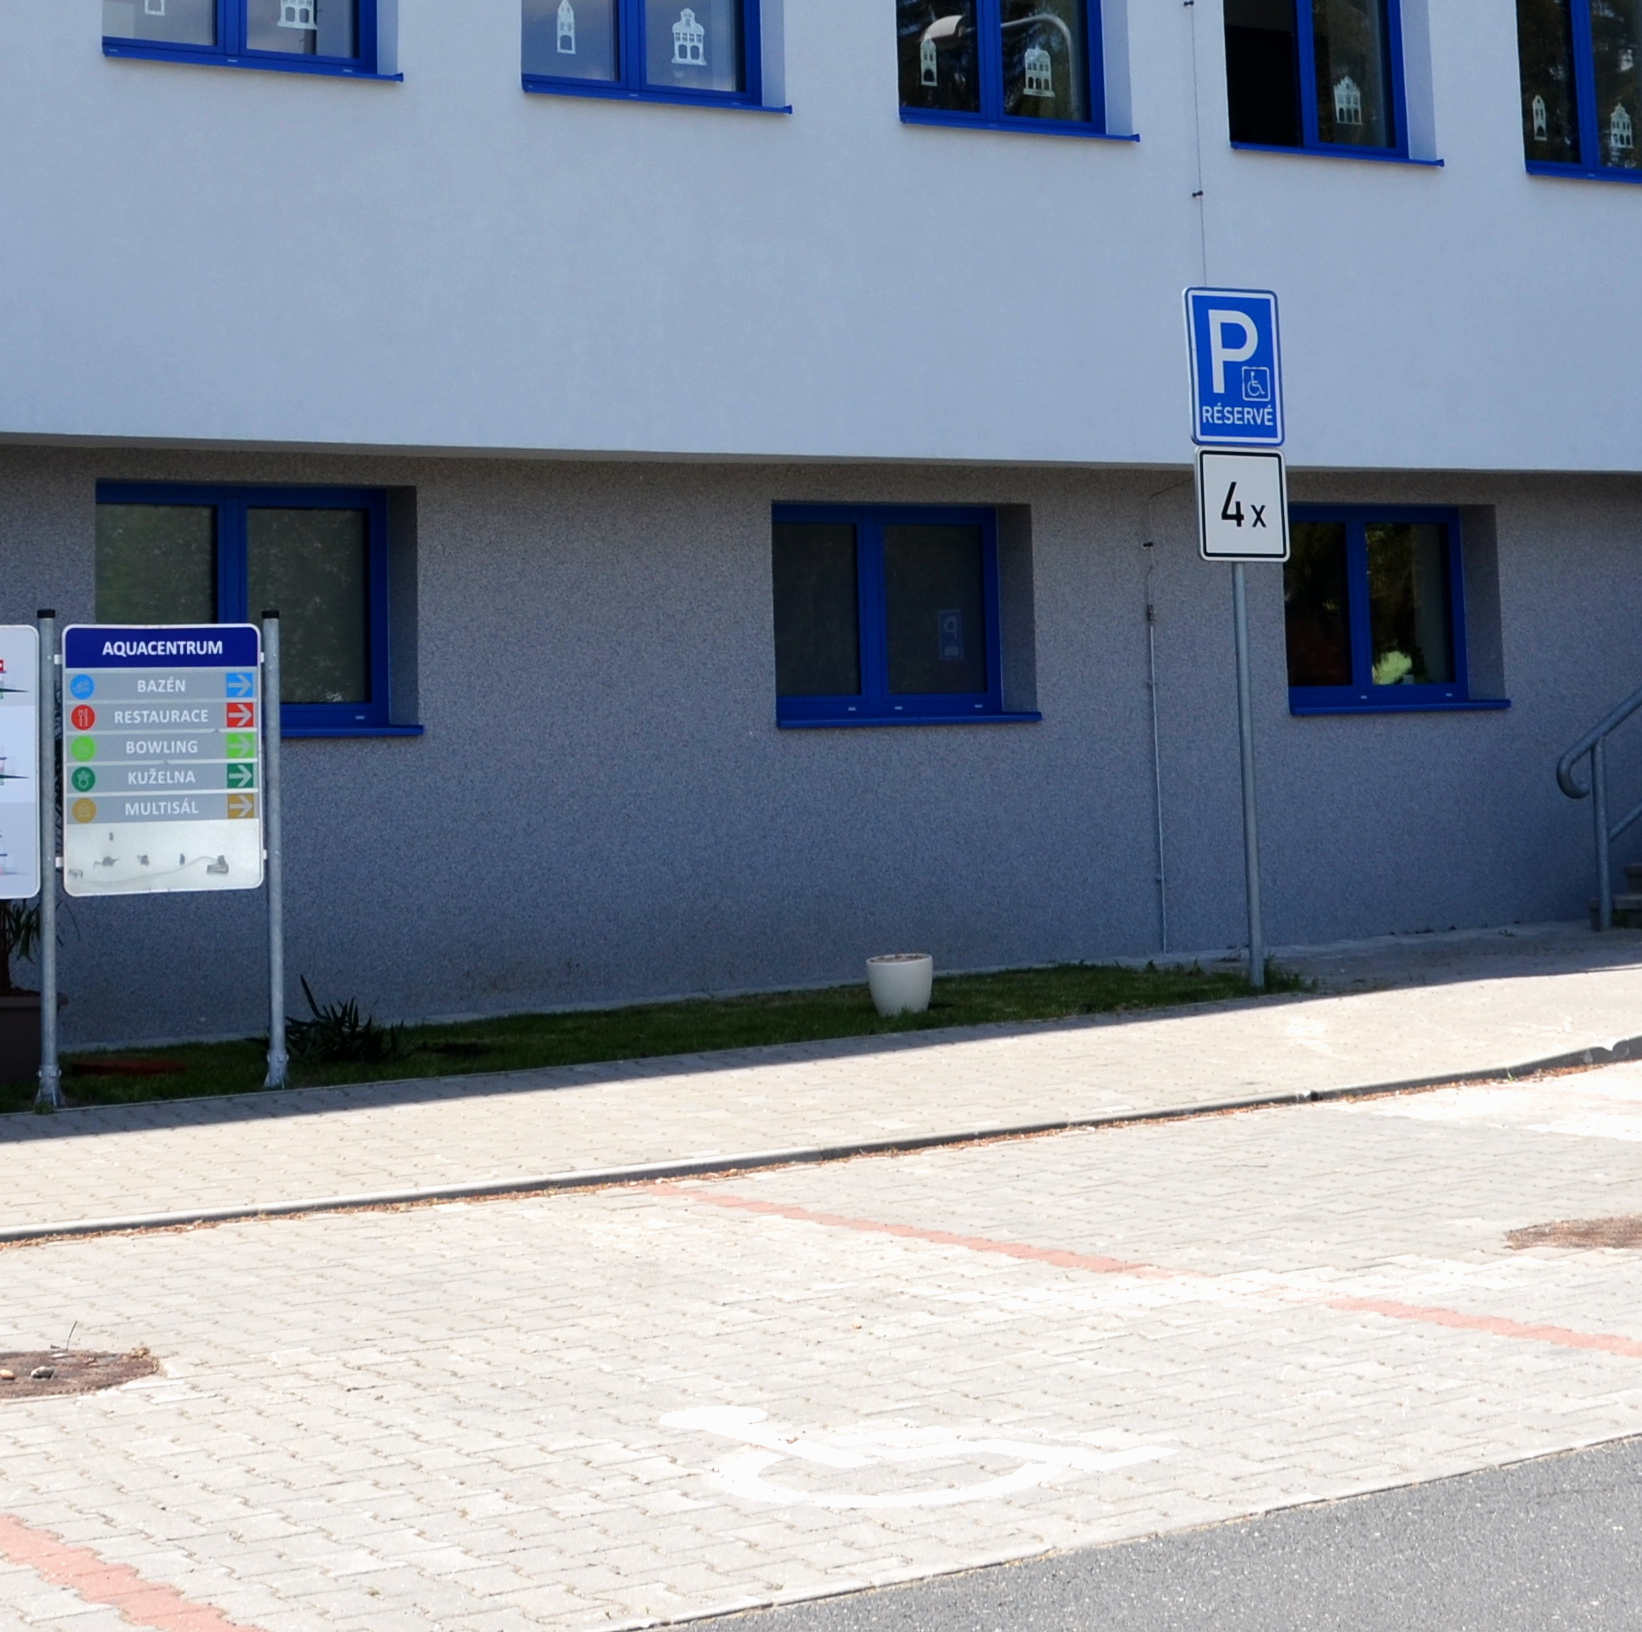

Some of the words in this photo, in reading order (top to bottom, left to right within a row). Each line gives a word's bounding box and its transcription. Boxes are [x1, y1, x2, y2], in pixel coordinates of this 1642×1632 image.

[1207, 309, 1259, 395] P
[1202, 401, 1274, 426] RÉSERVÉ
[102, 641, 223, 656] AQUACENTRUM
[137, 676, 186, 693] BAZÉN
[114, 709, 209, 724] RESTAURACE
[126, 740, 199, 754] BOWLING
[128, 768, 196, 785] KUŽELNA
[125, 798, 199, 816] MULTISÁL
